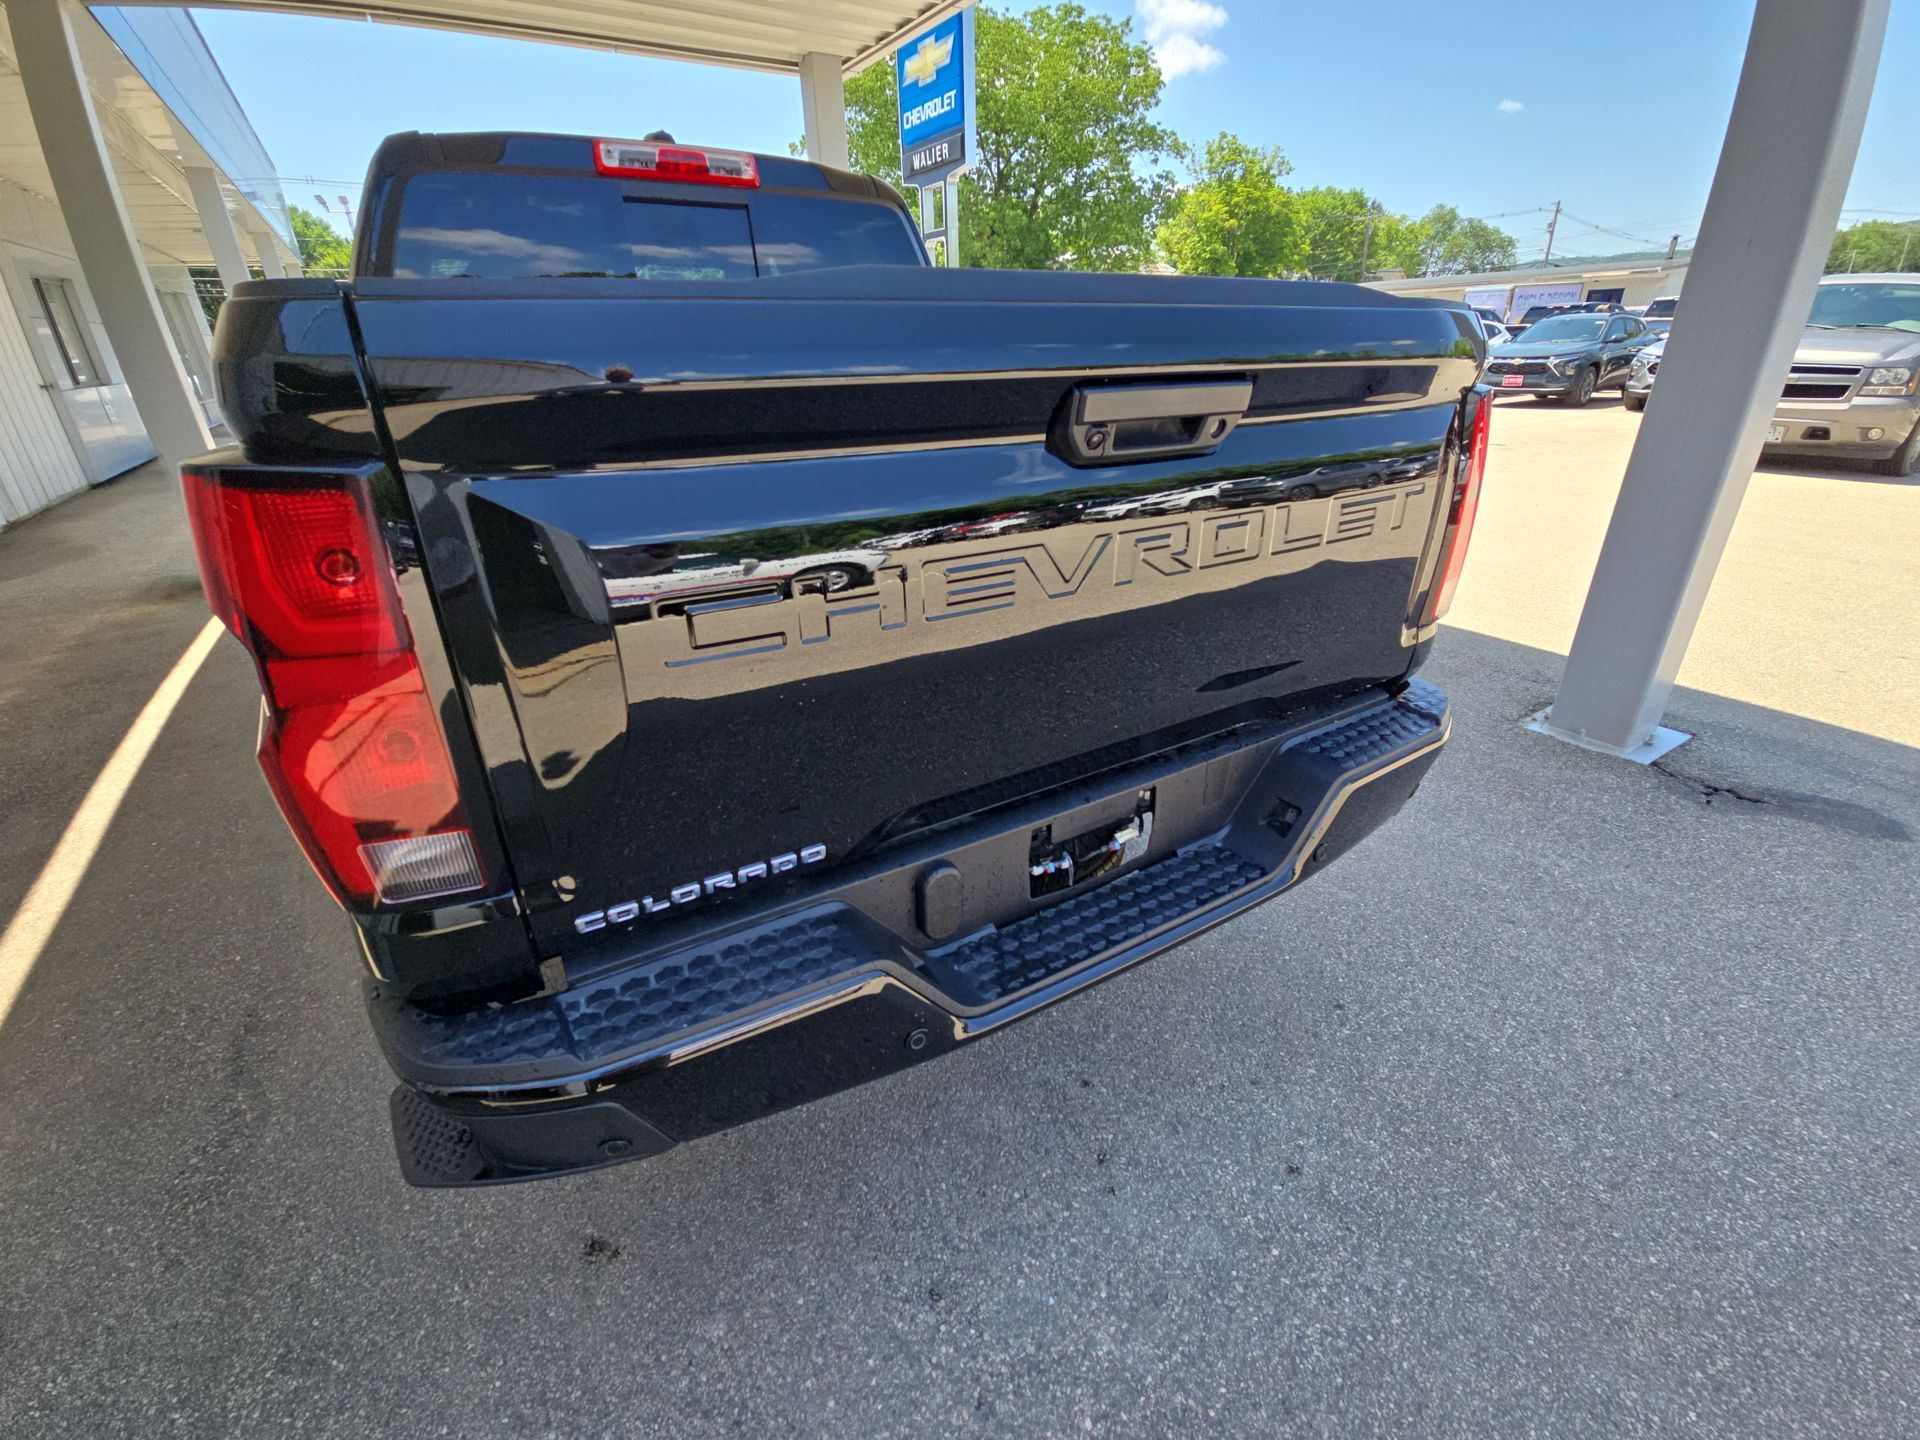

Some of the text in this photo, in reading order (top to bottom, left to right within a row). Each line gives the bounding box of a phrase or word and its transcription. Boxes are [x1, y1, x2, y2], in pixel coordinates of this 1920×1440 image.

[903, 89, 957, 130] CHEVROLET
[912, 142, 949, 171] WALIER
[656, 482, 1424, 667] CHEVROLET
[574, 842, 827, 935] COLORADO
